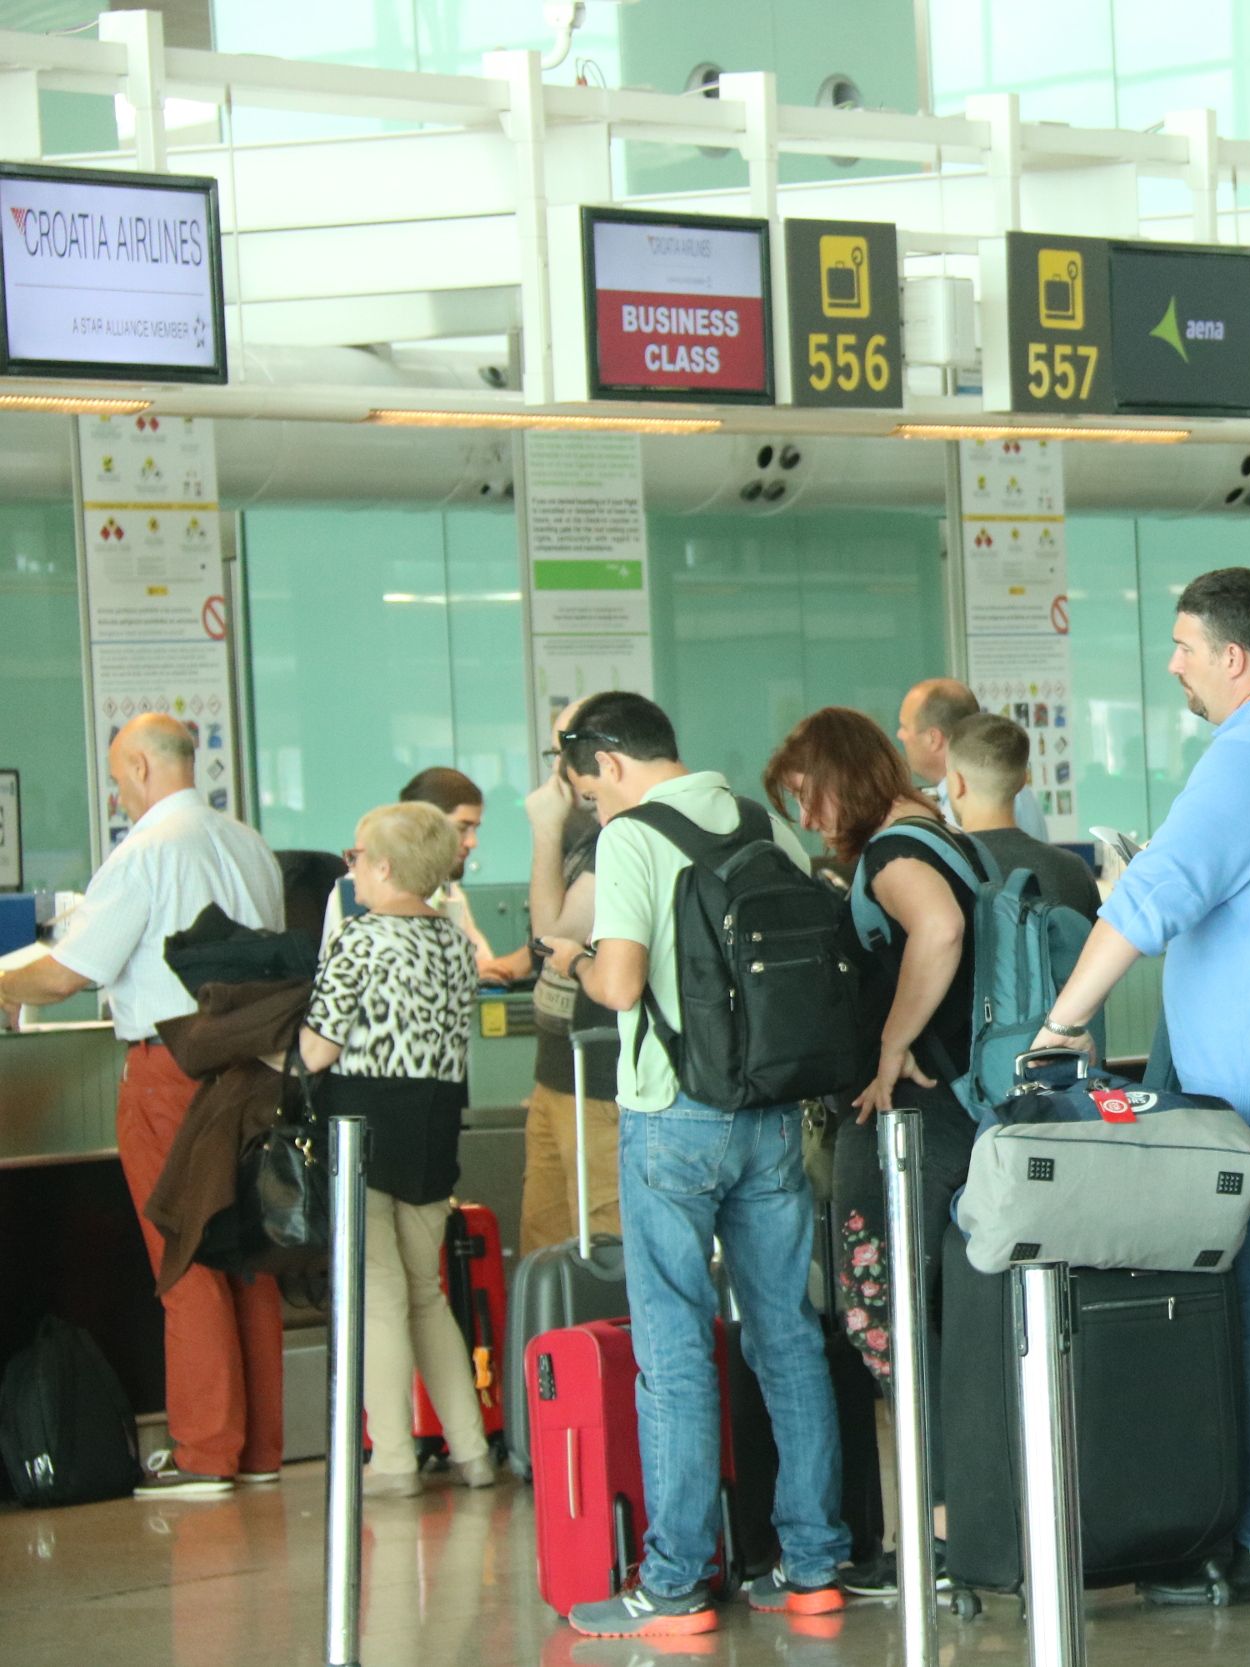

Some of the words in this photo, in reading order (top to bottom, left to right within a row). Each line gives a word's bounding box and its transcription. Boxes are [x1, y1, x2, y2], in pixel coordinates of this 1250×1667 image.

[24, 208, 111, 260] CROATIA
[116, 215, 202, 266] AIRLINES
[621, 304, 739, 337] BUSINESS
[1185, 318, 1225, 341] aena
[644, 344, 720, 374] CLASS
[808, 333, 889, 392] 556
[1028, 343, 1099, 400] 557
[622, 1590, 655, 1617] N
